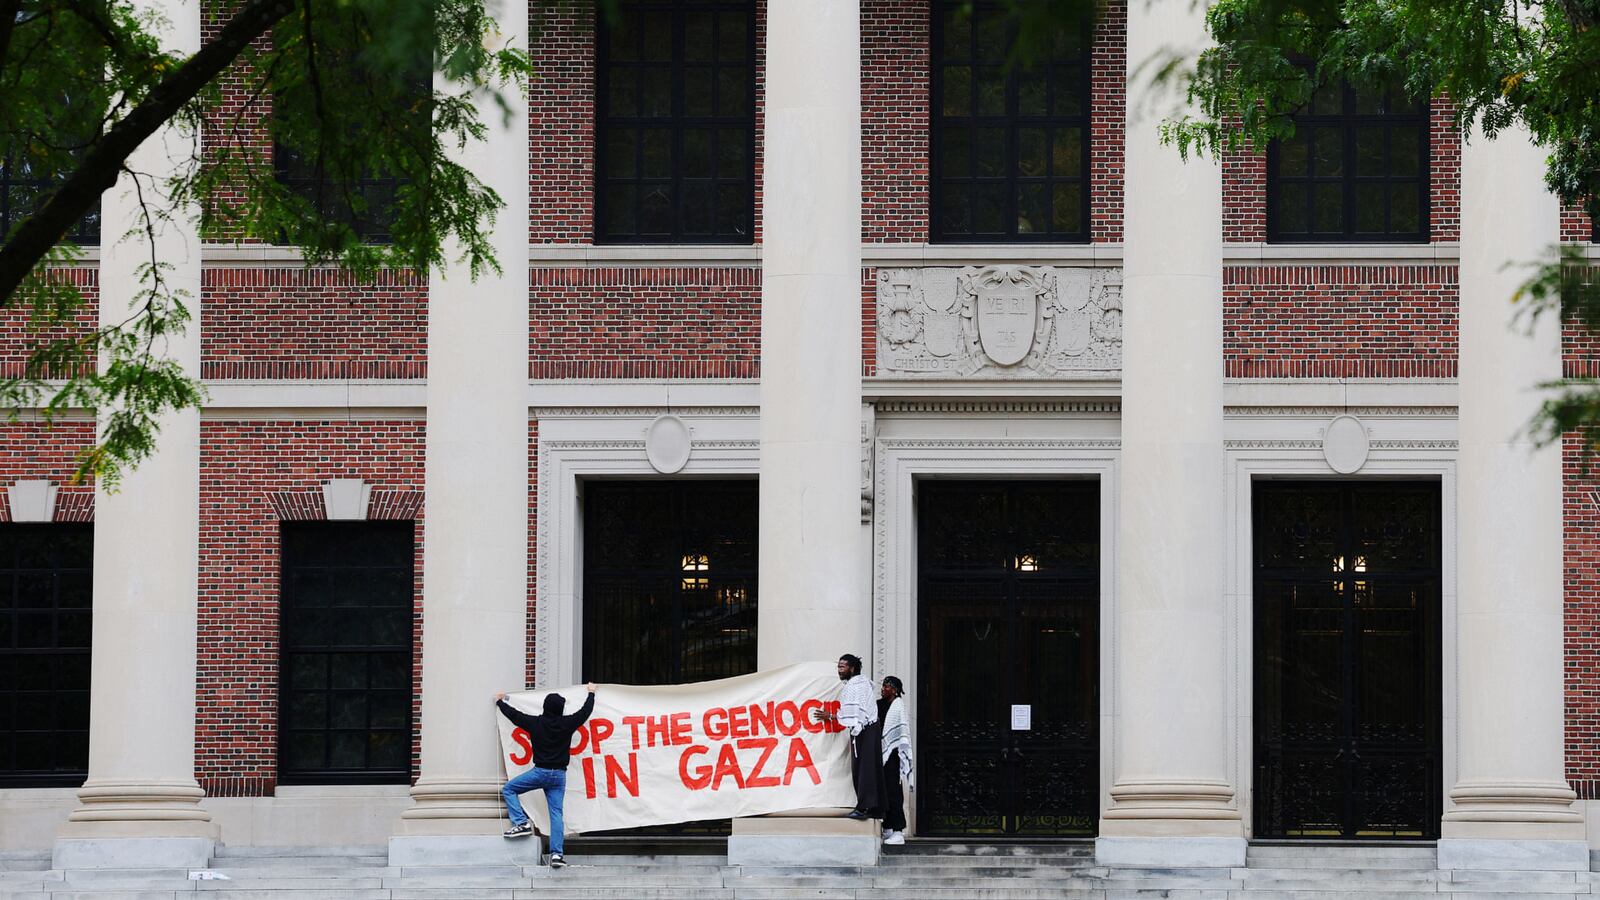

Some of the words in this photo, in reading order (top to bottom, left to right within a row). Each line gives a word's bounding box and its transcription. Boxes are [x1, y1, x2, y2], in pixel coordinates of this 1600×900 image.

[894, 358, 940, 368] CHRISTO
[944, 358, 957, 368] ET
[509, 718, 614, 766] SOP
[622, 712, 692, 750] THE
[702, 699, 847, 741] GENOCID
[581, 752, 640, 799] IN
[678, 737, 821, 791] GAZA
